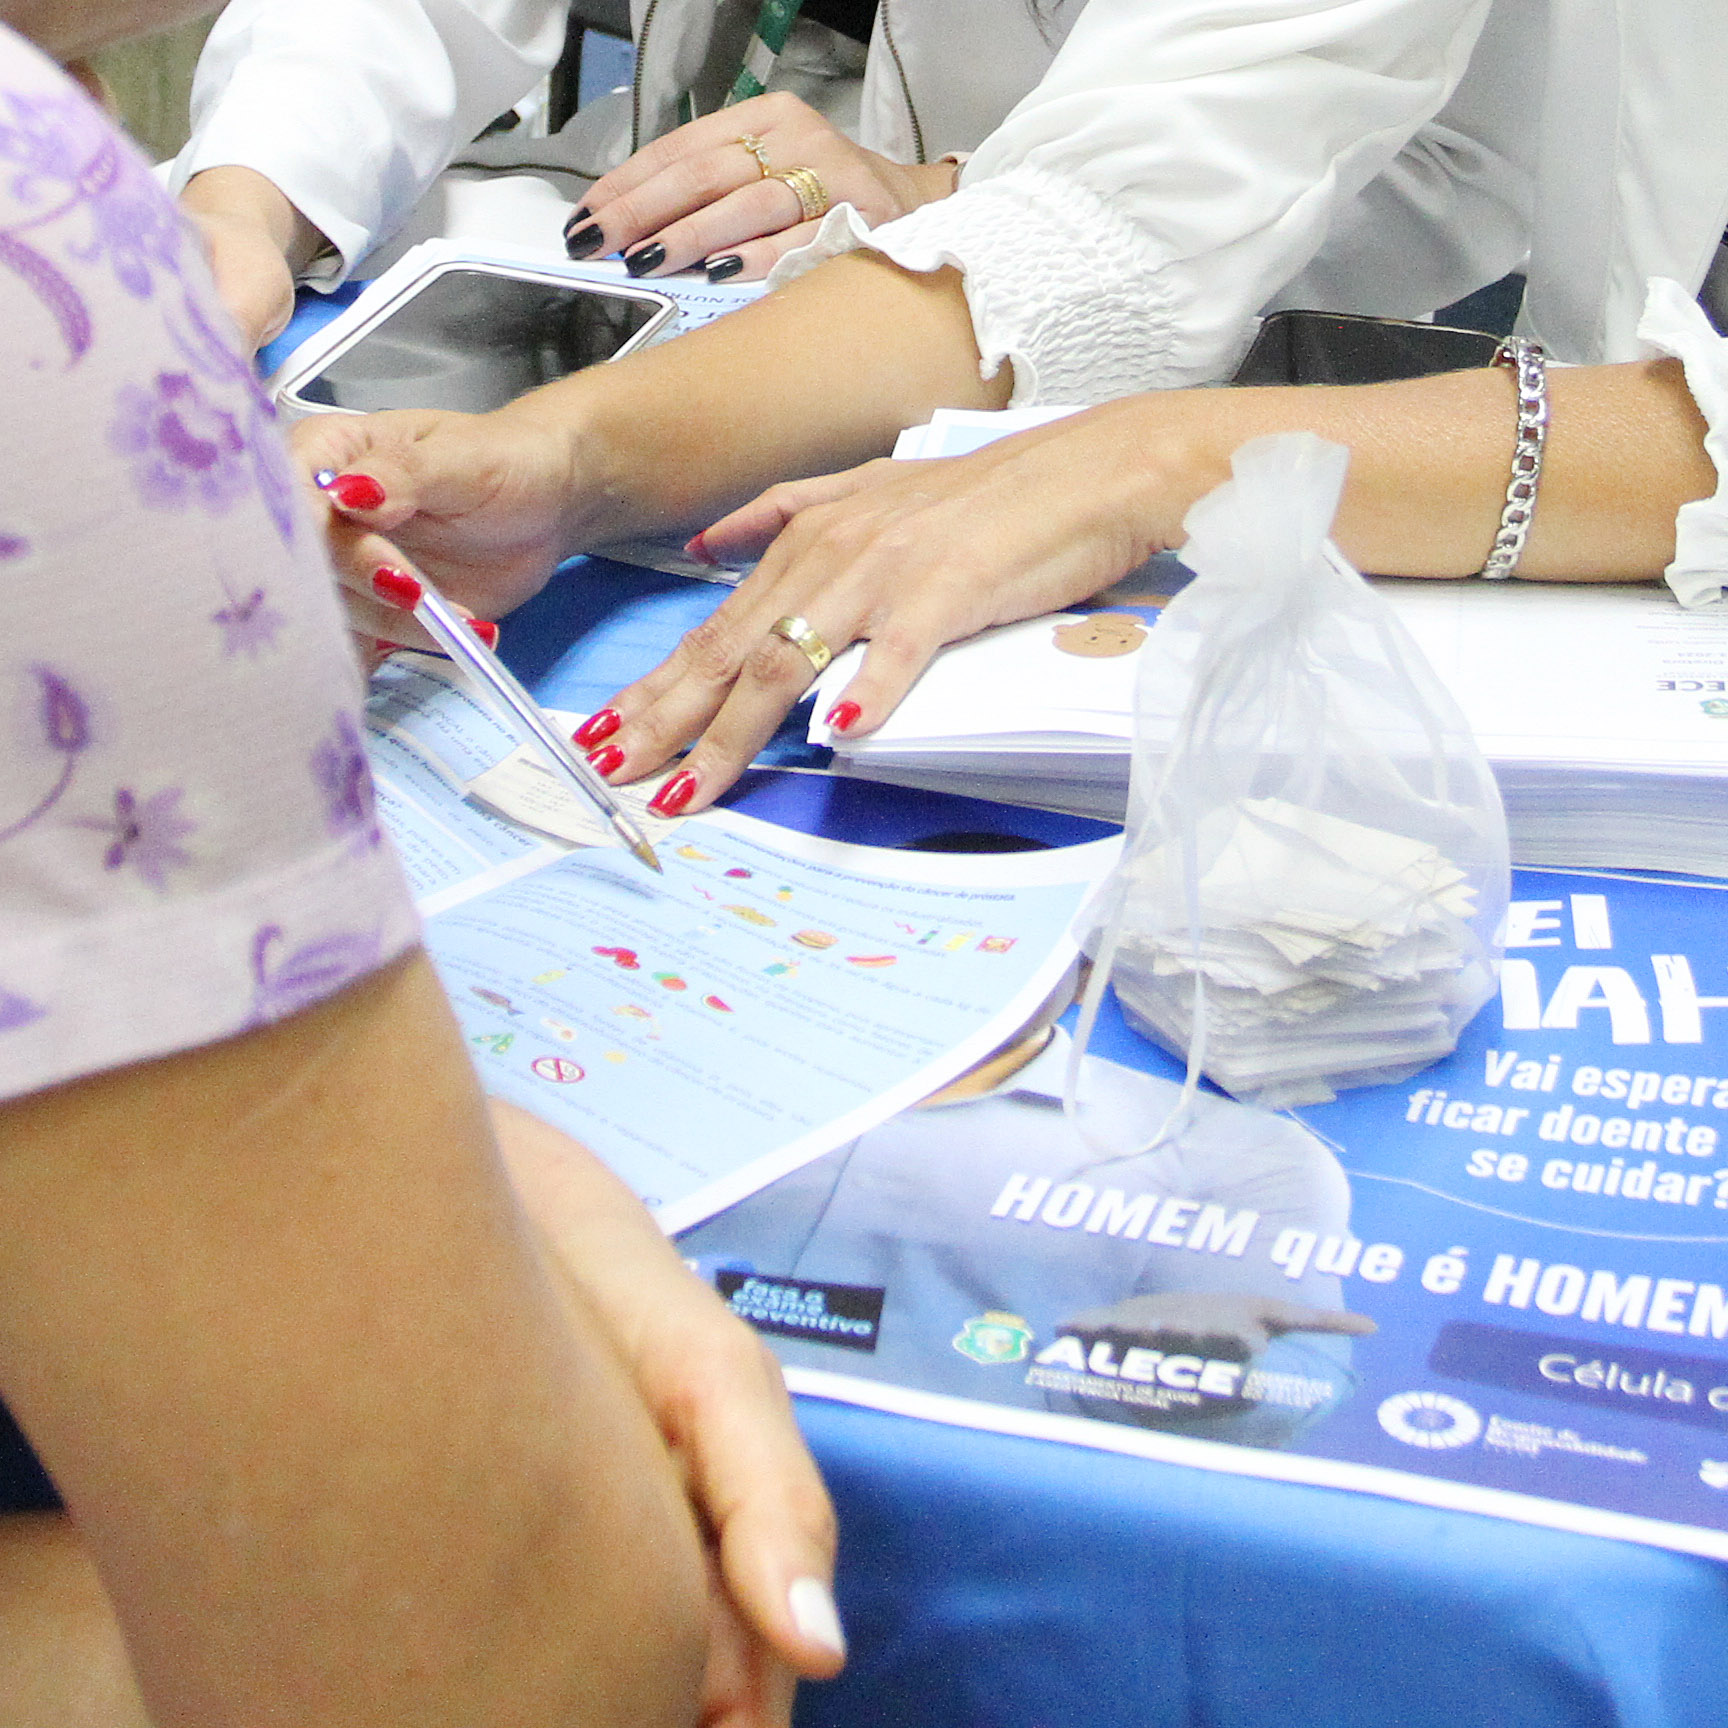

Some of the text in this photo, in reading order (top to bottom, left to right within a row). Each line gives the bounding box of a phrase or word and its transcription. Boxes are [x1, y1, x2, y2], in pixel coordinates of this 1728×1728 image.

[1484, 1048, 1563, 1093] Vai
[1404, 1088, 1530, 1136] ficar
[1538, 1103, 1719, 1158] doente
[1464, 1147, 1530, 1182] se
[989, 1171, 1261, 1258] HOMEM
[1270, 1228, 1405, 1280] que
[1420, 1245, 1470, 1295] é
[1034, 1334, 1241, 1398] ALECE
[1536, 1352, 1696, 1404] Célula
